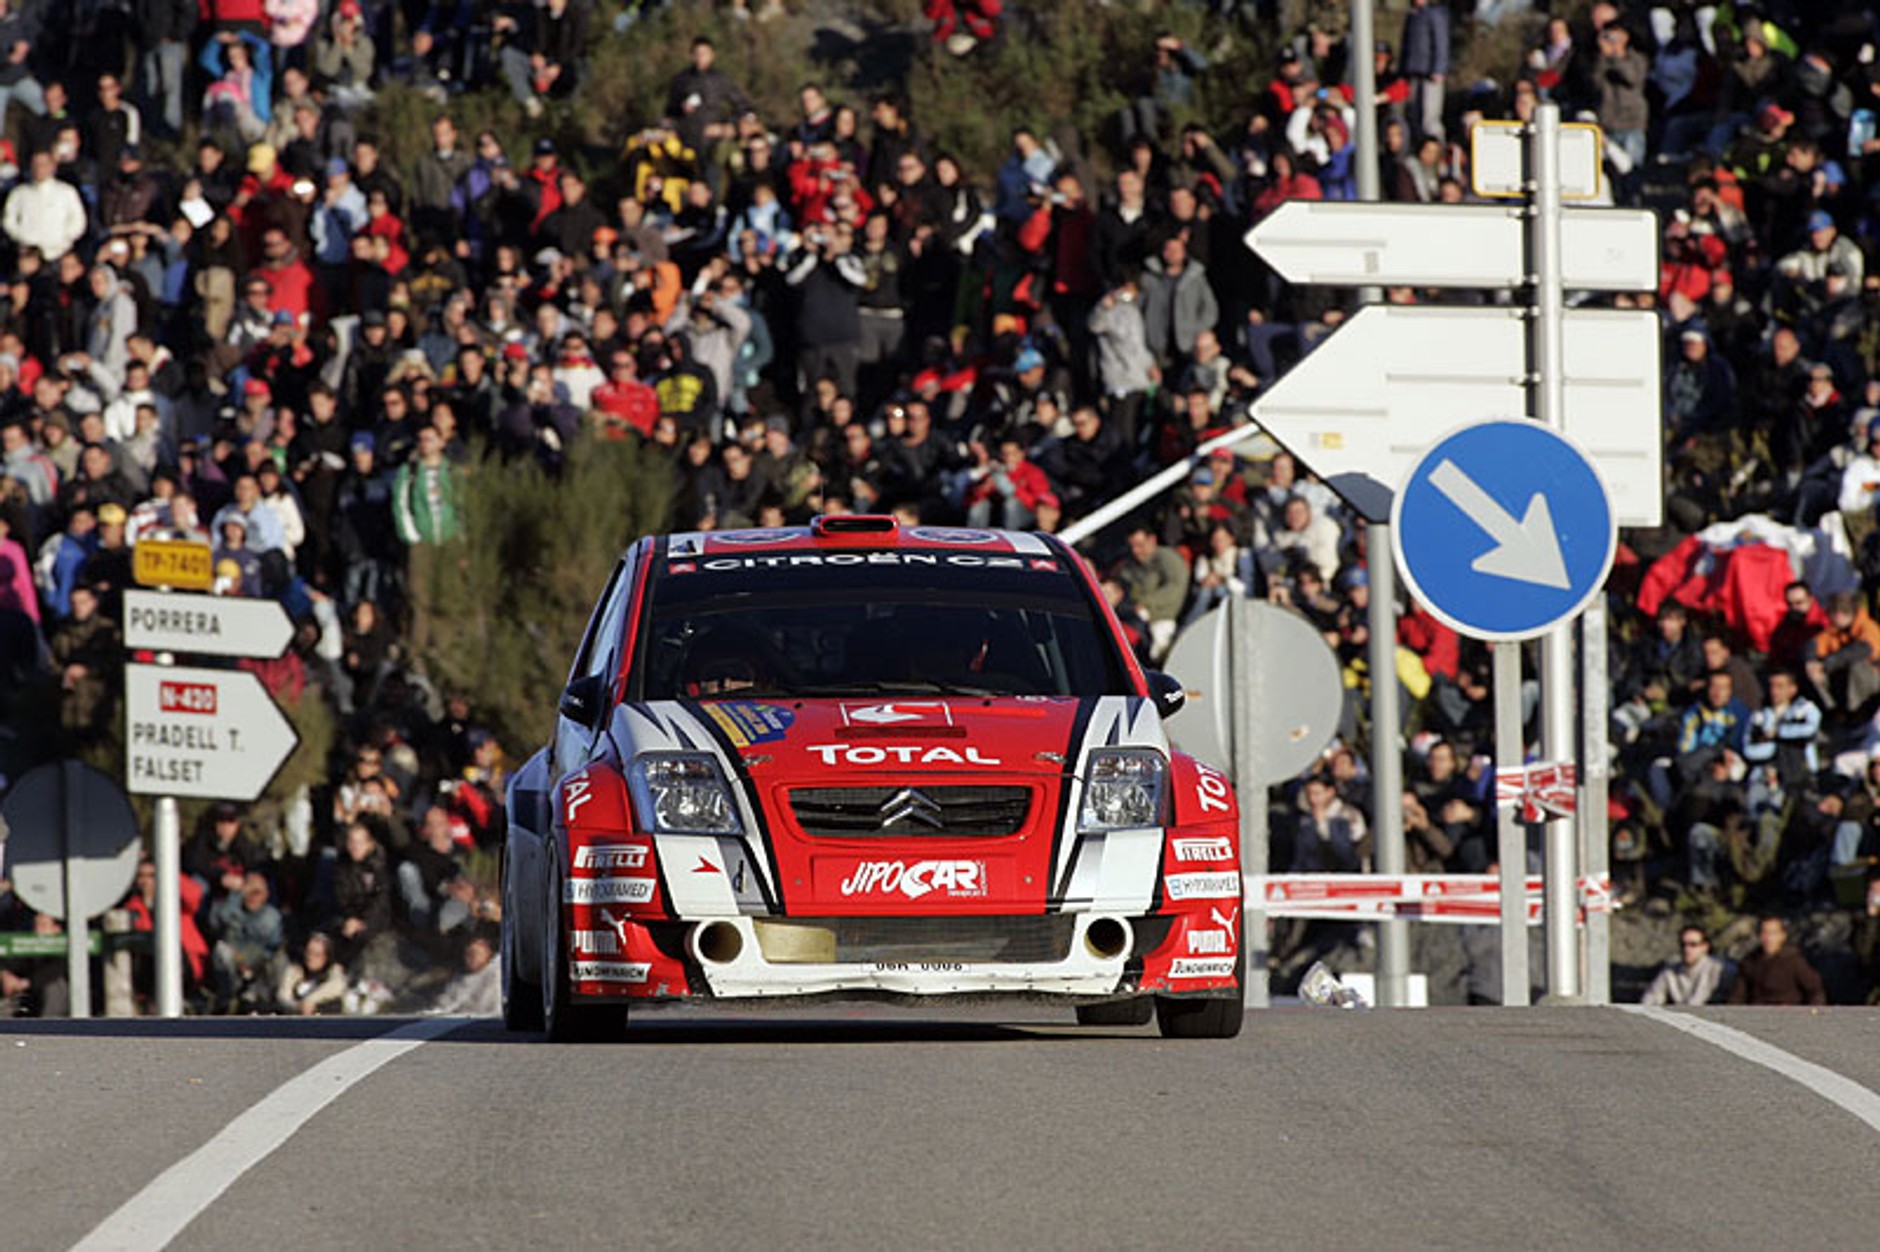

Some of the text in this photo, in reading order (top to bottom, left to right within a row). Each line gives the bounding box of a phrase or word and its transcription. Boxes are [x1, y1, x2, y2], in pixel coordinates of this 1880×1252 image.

[703, 552, 937, 570] CITROËN
[129, 607, 221, 635] PORRERA
[161, 683, 215, 711] N-420
[133, 723, 219, 751] PRADELL
[806, 744, 1001, 765] TOTAL
[133, 760, 205, 783] FALSET
[573, 844, 649, 868] PIRELLI
[1171, 837, 1234, 861] PIRELLI
